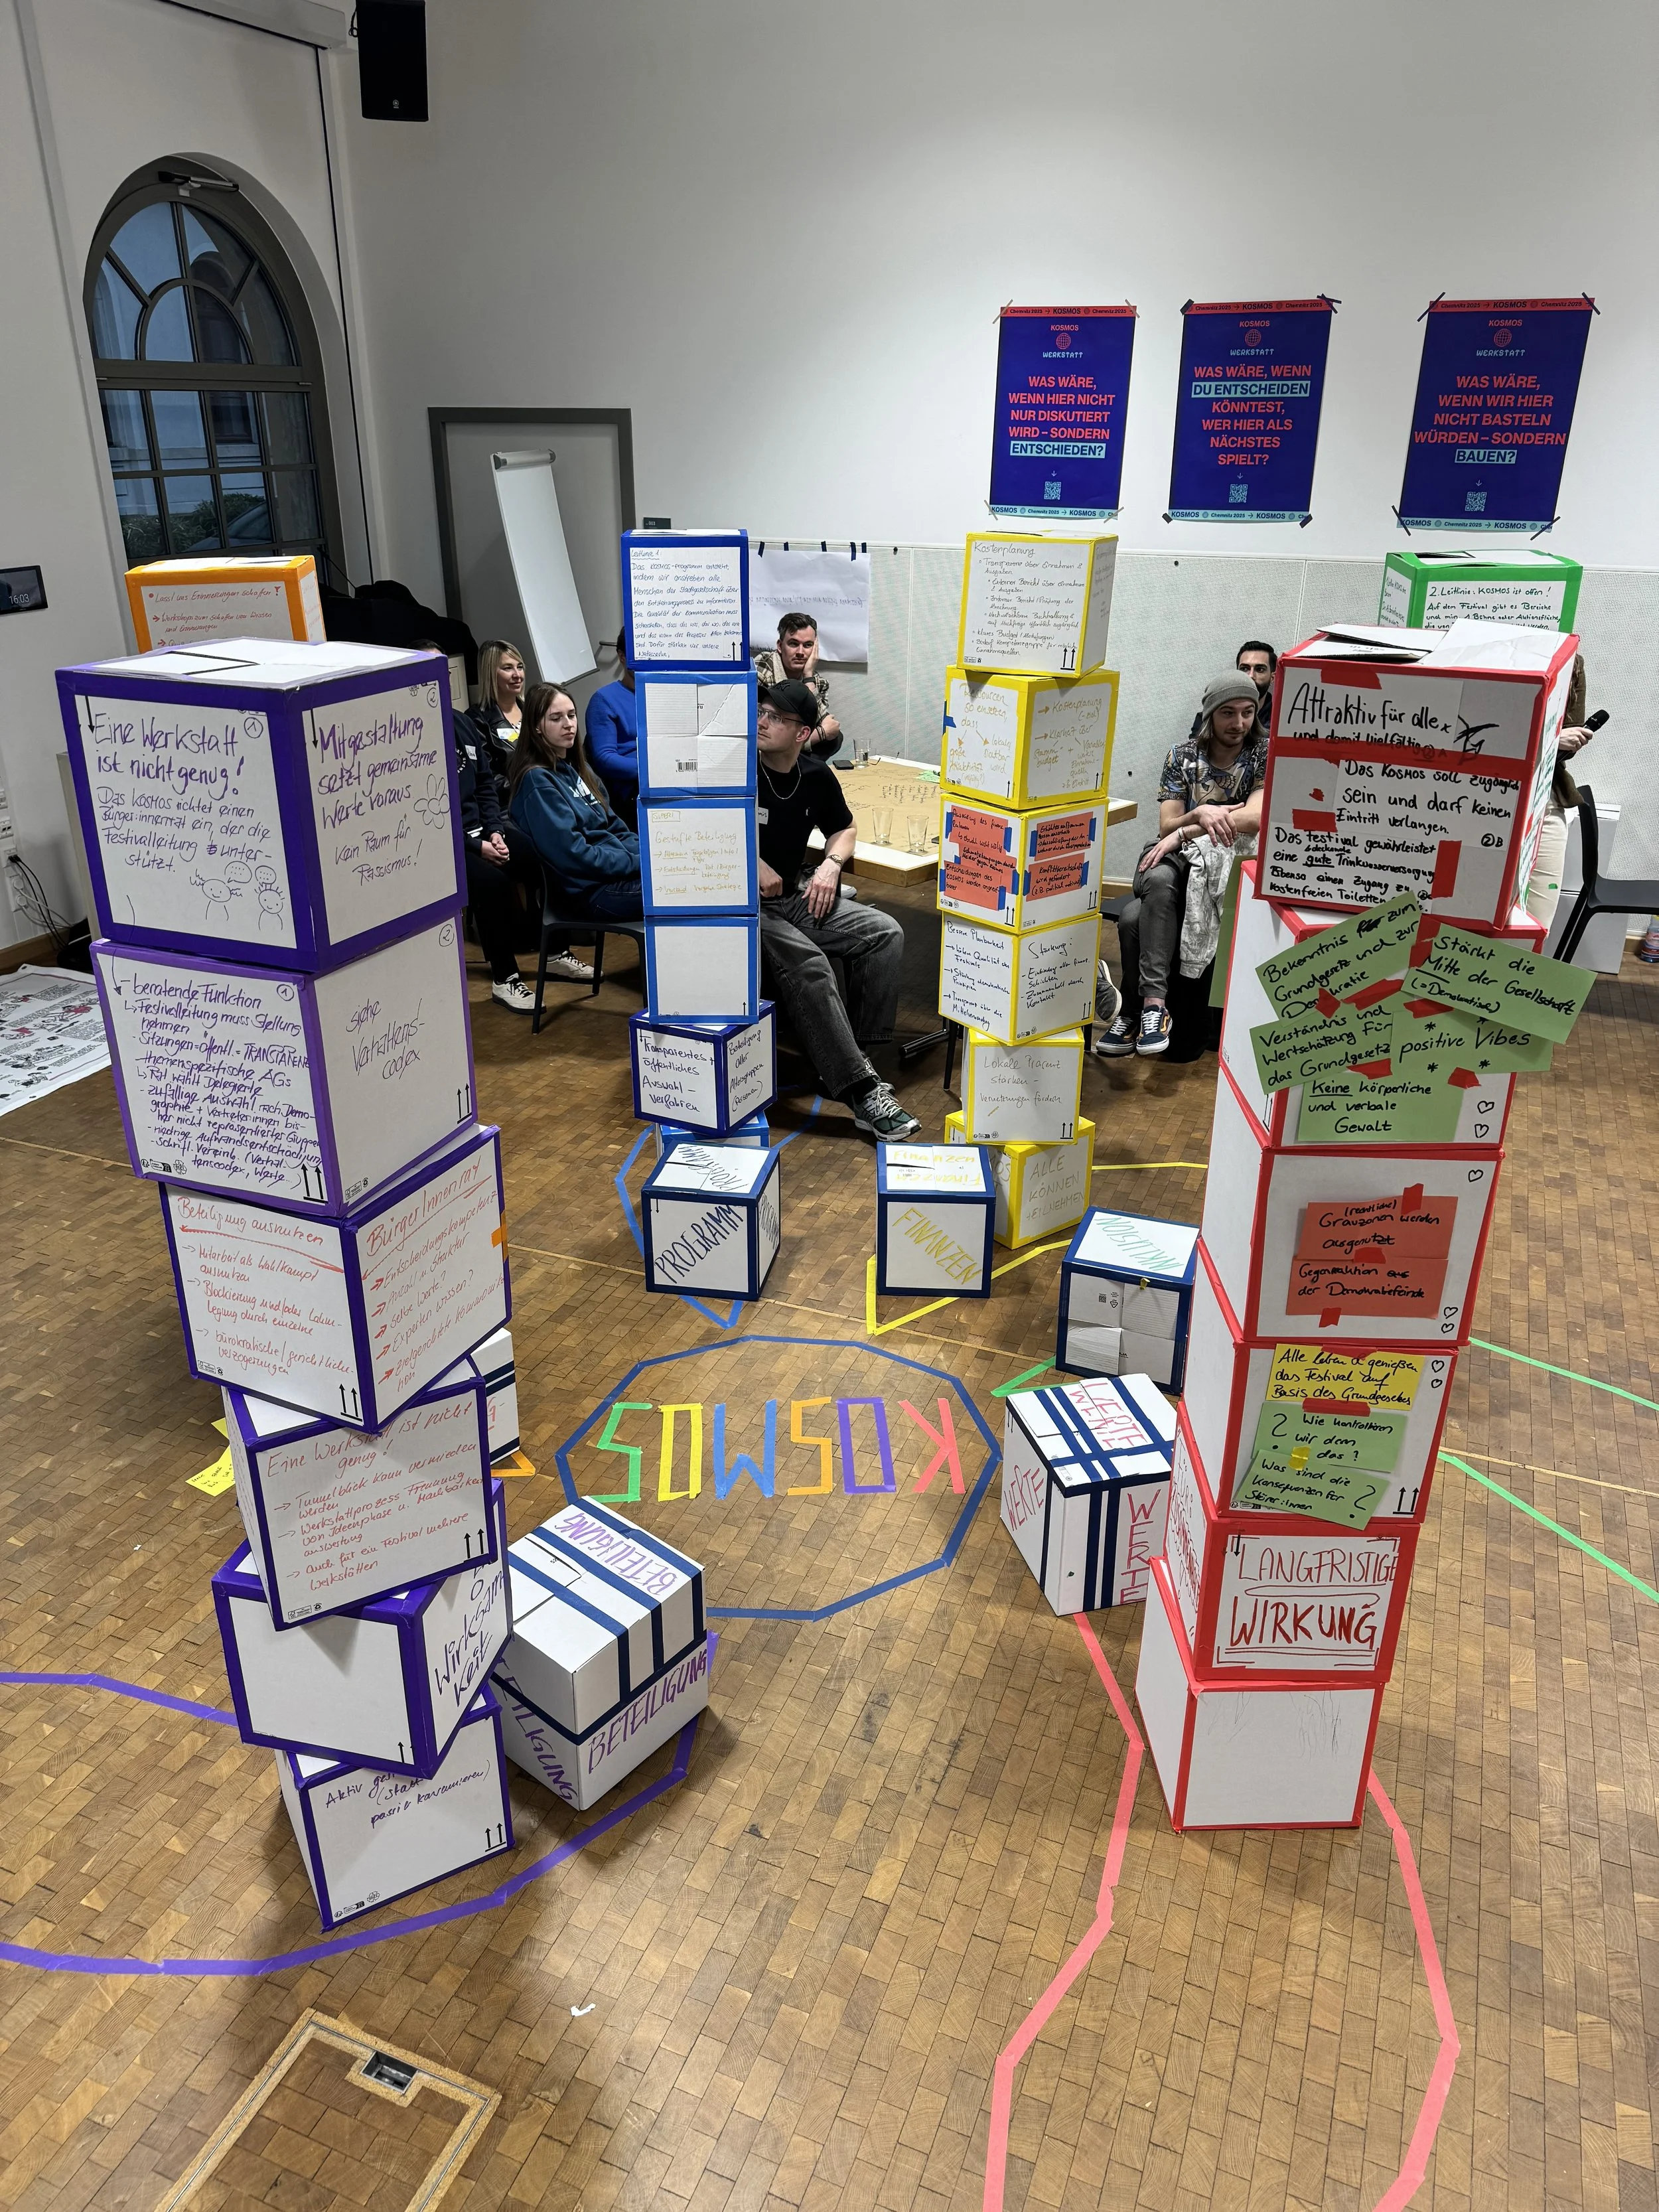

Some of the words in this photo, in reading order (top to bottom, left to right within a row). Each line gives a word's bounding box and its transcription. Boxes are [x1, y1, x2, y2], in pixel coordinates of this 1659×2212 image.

[1029, 376, 1055, 388] WAS
[1058, 374, 1096, 390] WÄRE,
[1194, 366, 1222, 378] WAS
[1226, 364, 1267, 379] WÄRE,
[1271, 365, 1311, 376] WENN
[1457, 376, 1489, 388] WAS
[1493, 374, 1541, 390] WÄRE,
[1009, 393, 1044, 404] WENN
[1047, 394, 1074, 405] HIER
[1078, 394, 1116, 406] NICHT
[1193, 384, 1212, 396] DU
[1214, 383, 1309, 396] ENTSCHEIDEN
[1439, 395, 1482, 407] WENN
[1486, 395, 1514, 407] WIR
[1517, 395, 1553, 407] HIER
[1011, 410, 1035, 420] NUR
[1038, 411, 1110, 422] DISKUTIERT
[1212, 400, 1285, 415] KÖNNTEST,
[1434, 413, 1479, 425] NICHT
[1482, 414, 1551, 426] BASTELN
[1009, 427, 1039, 437] WIRD
[1050, 427, 1110, 439] SONDERN
[1202, 419, 1231, 430] WER
[1234, 419, 1263, 430] HIER
[1266, 419, 1293, 430] ALS
[1414, 429, 1479, 443] WÜRDEN
[1491, 432, 1567, 445] SONDERN
[1012, 443, 1104, 455] ENTSCHIEDEN?
[1210, 435, 1281, 448] NÄCHSTES
[1218, 454, 1269, 465] SPIELT?
[1456, 450, 1516, 463] BAUEN?
[975, 542, 1035, 557] Kostenplanung
[9, 594, 29, 604] 16:03
[1492, 604, 1506, 613] gibt
[1287, 682, 1376, 725] Attraktiv
[1381, 700, 1406, 729] für
[1411, 706, 1439, 729] alle
[95, 713, 135, 745] Eine
[142, 717, 238, 757] Werkstatt
[319, 711, 424, 771] Mitgestaltung
[96, 750, 123, 773] ist
[130, 754, 175, 782] nicht
[173, 756, 244, 800] genug!
[318, 761, 361, 794] setzt
[362, 750, 437, 797] gemeinsame
[323, 792, 366, 829] Werte
[370, 785, 411, 810] voraus
[1342, 786, 1376, 804] sein
[1388, 796, 1417, 809] und
[1427, 791, 1468, 814] darf
[1472, 800, 1511, 818] keinen
[362, 831, 390, 852] Raum
[394, 813, 411, 851] für
[1336, 808, 1380, 824] Eintritt
[1388, 816, 1449, 836] verlangen.
[1275, 827, 1302, 844] Das
[1307, 830, 1359, 847] Festival
[1366, 838, 1436, 853] gewährleistet
[352, 838, 422, 886] Rassismus!
[1435, 936, 1496, 960] Stärkt
[1508, 958, 1536, 974] die
[133, 973, 199, 1006] beratende
[197, 984, 261, 1009] Funktion
[1420, 956, 1461, 975] Mitte
[1468, 970, 1498, 985] der
[1504, 980, 1576, 1015] Gesellschaft
[1260, 1016, 1347, 1047] Verständnis
[1356, 1005, 1392, 1020] und
[1262, 1031, 1356, 1065] Wertschätzung
[1399, 1033, 1465, 1063] positive
[1475, 1027, 1531, 1049] Vibes
[1268, 1070, 1292, 1086] das
[1301, 1043, 1391, 1077] Grundgesetz
[1312, 1080, 1350, 1094] Keine
[1359, 1081, 1432, 1096] körperliche
[1308, 1101, 1336, 1112] und
[1346, 1101, 1396, 1111] verbale
[1334, 1117, 1393, 1134] Gewalt
[1030, 1155, 1065, 1181] ALLE
[1029, 1174, 1080, 1203] KÖNNEN
[178, 1197, 246, 1232] Beteiligung
[1319, 1213, 1394, 1228] Grauzonen
[1400, 1213, 1439, 1226] werden
[654, 1204, 744, 1284] PROGRAMM
[892, 1207, 982, 1285] FINANZEN
[1094, 1217, 1184, 1271] INKLUSION
[1277, 1348, 1307, 1364] Alle
[1275, 1368, 1301, 1382] das
[1305, 1368, 1354, 1382] Festival
[1271, 1386, 1309, 1399] Basis
[1313, 1386, 1336, 1400] des
[592, 1396, 966, 1503] KOSMOS
[1004, 1465, 1045, 1531] WERTE
[553, 1512, 678, 1596] BETEILIGUNG
[1120, 1489, 1161, 1605] WERTE
[1239, 1543, 1400, 1584] LANGFRISTIGE
[1230, 1595, 1378, 1651] WIRKUNG
[587, 1649, 708, 1775] BETEILIGUNG
[325, 1782, 362, 1808] Aktiv
